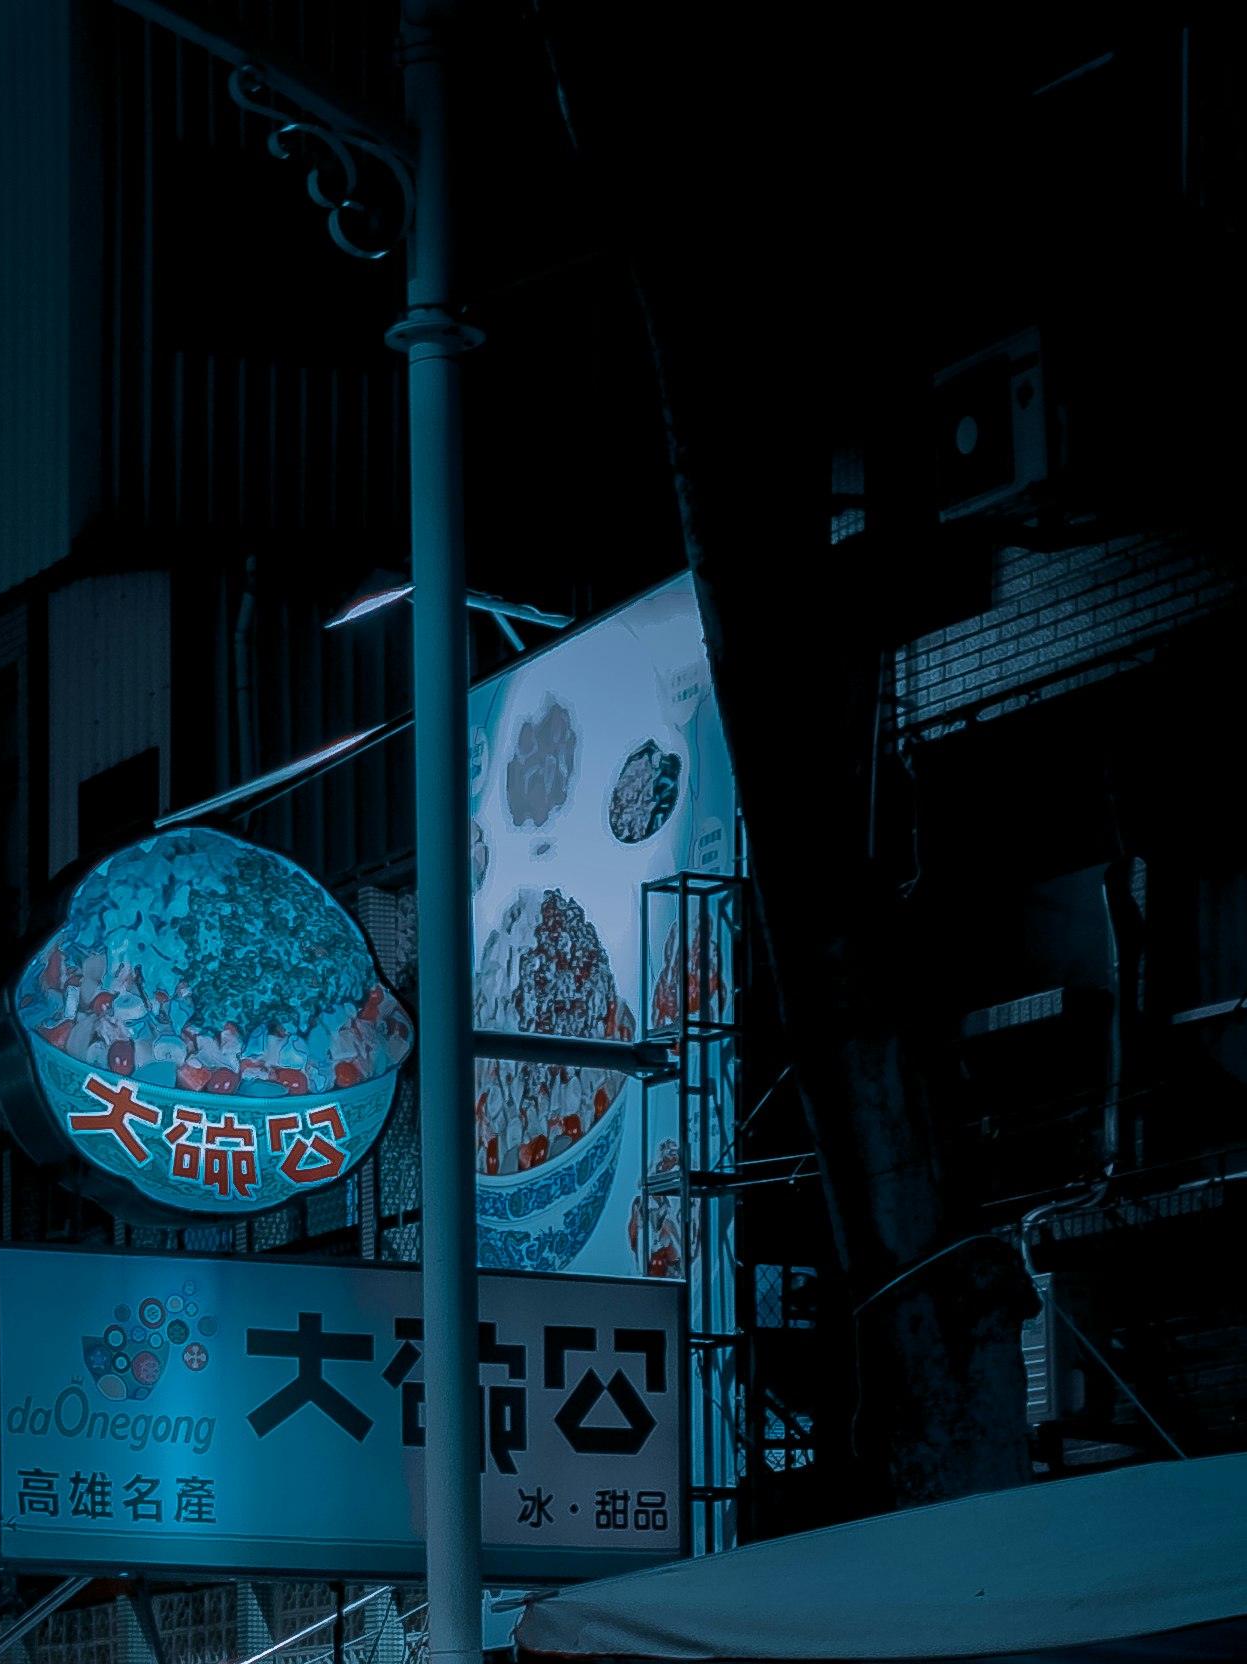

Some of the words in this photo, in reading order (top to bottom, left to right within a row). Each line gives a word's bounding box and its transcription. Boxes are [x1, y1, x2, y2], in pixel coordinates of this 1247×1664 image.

[69, 1076, 348, 1198] 大碗公
[6, 1374, 217, 1453] daOnegong
[246, 1311, 667, 1474] 大碗公
[15, 1467, 219, 1525] 高雄名產
